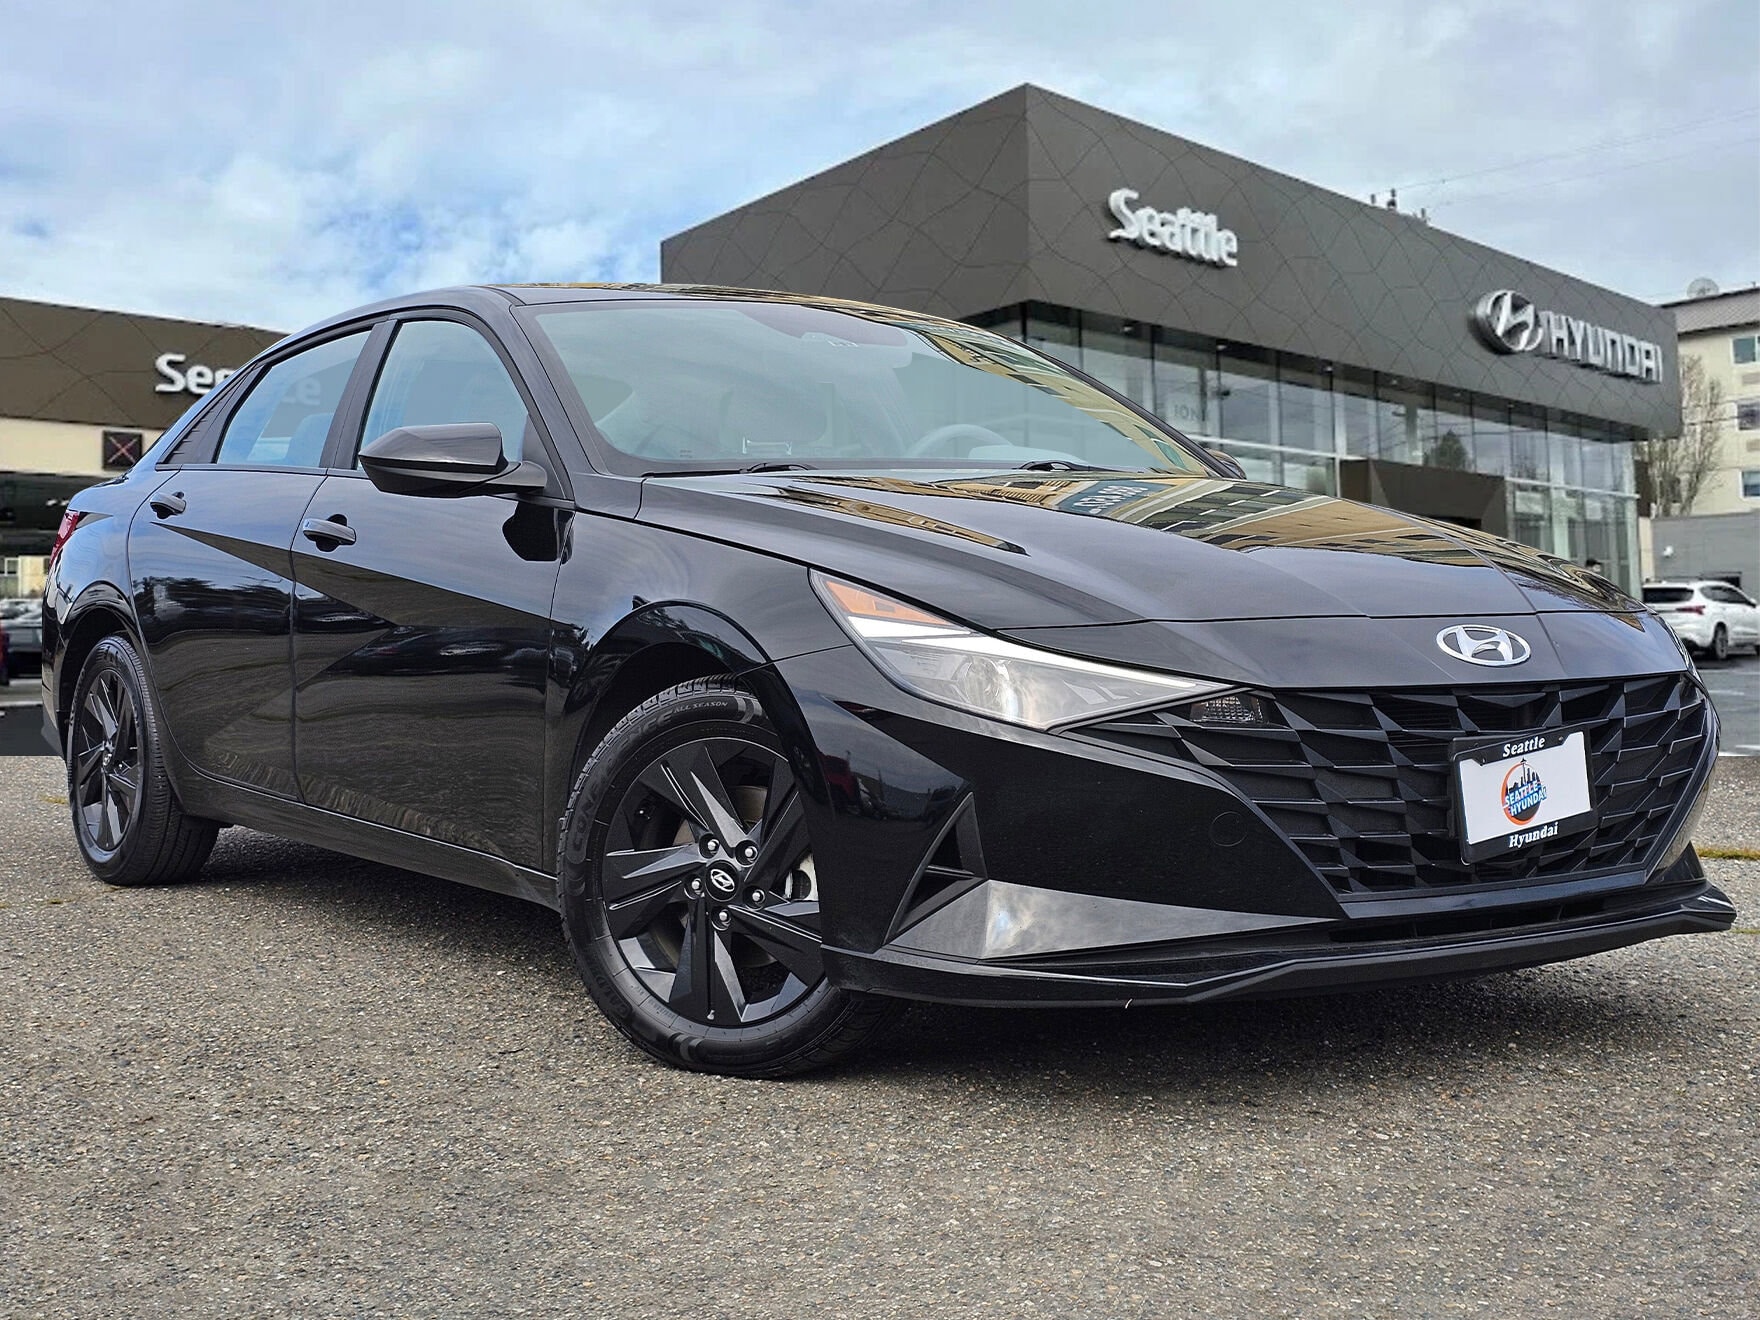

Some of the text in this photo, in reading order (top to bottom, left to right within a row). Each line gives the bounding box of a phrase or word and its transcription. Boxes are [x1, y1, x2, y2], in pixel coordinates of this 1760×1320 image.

[1108, 188, 1238, 267] Seattle
[1541, 311, 1663, 383] HYUNDAI
[1502, 736, 1546, 758] Seattle
[1504, 779, 1539, 807] SEATTLE
[1509, 785, 1548, 816] HYUNDAI
[1508, 822, 1559, 849] Hyundai
